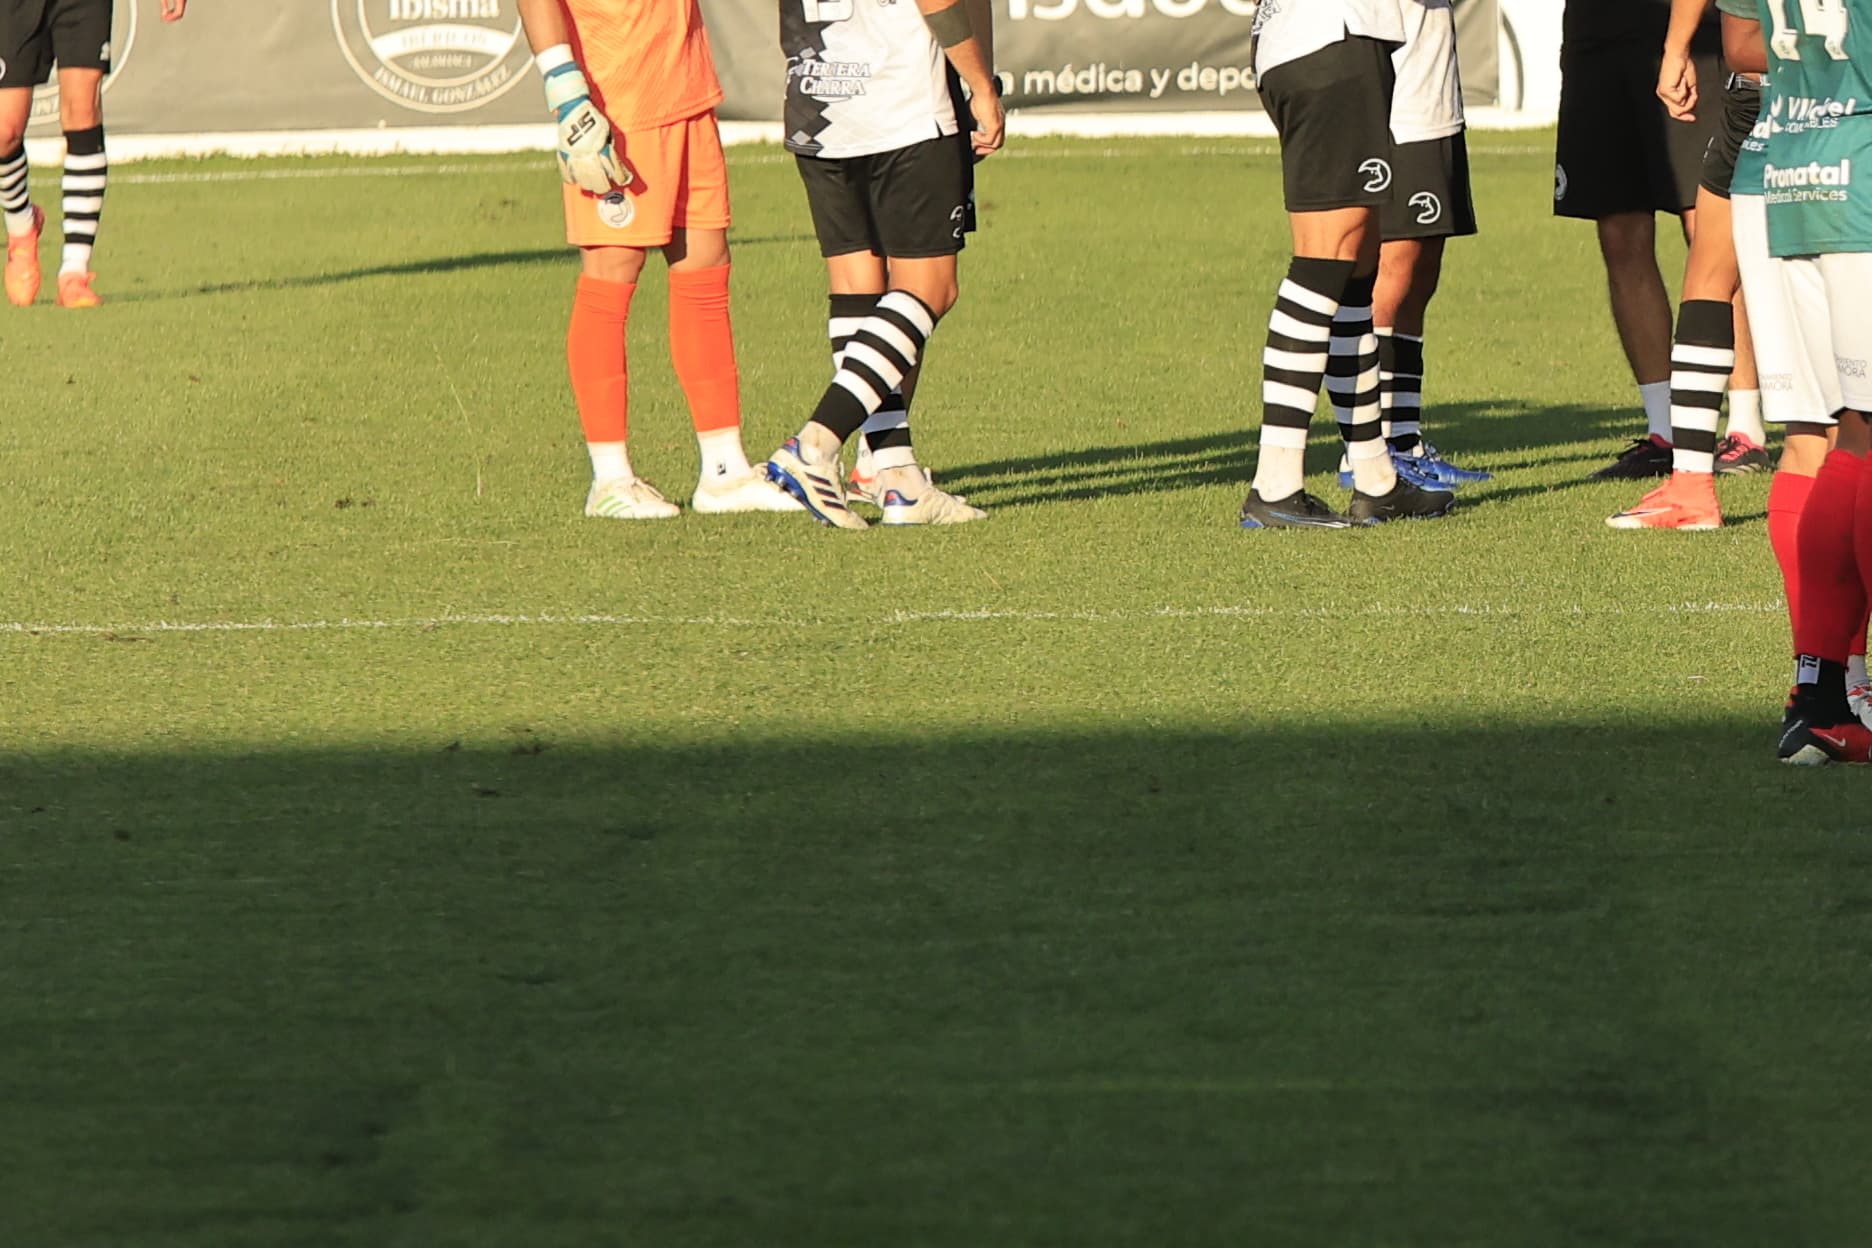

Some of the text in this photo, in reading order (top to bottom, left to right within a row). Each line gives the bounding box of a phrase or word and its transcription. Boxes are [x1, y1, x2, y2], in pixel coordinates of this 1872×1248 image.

[1024, 62, 1143, 96] médica
[1150, 67, 1170, 98] y
[1764, 159, 1850, 188] Pronatal
